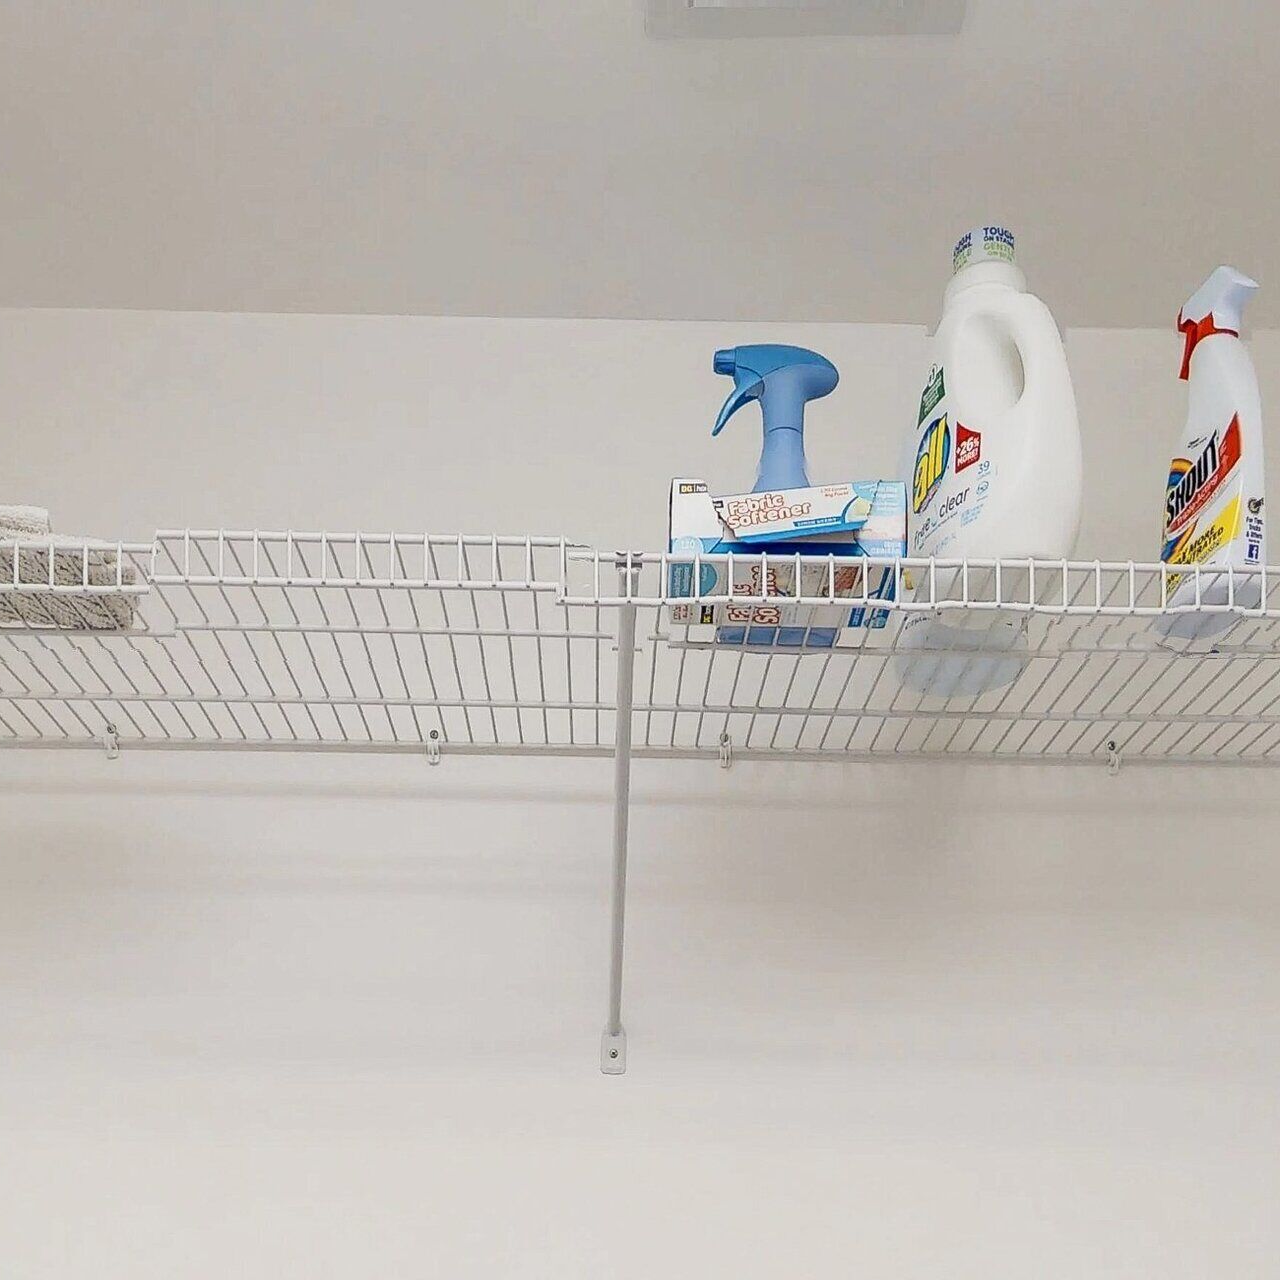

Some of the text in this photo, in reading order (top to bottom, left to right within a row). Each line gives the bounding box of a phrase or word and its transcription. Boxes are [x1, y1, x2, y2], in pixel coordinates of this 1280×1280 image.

[913, 412, 947, 514] all
[1166, 429, 1217, 529] SHOUT
[726, 503, 812, 529] Softener
[727, 494, 784, 516] Fabric
[939, 487, 970, 518] clear
